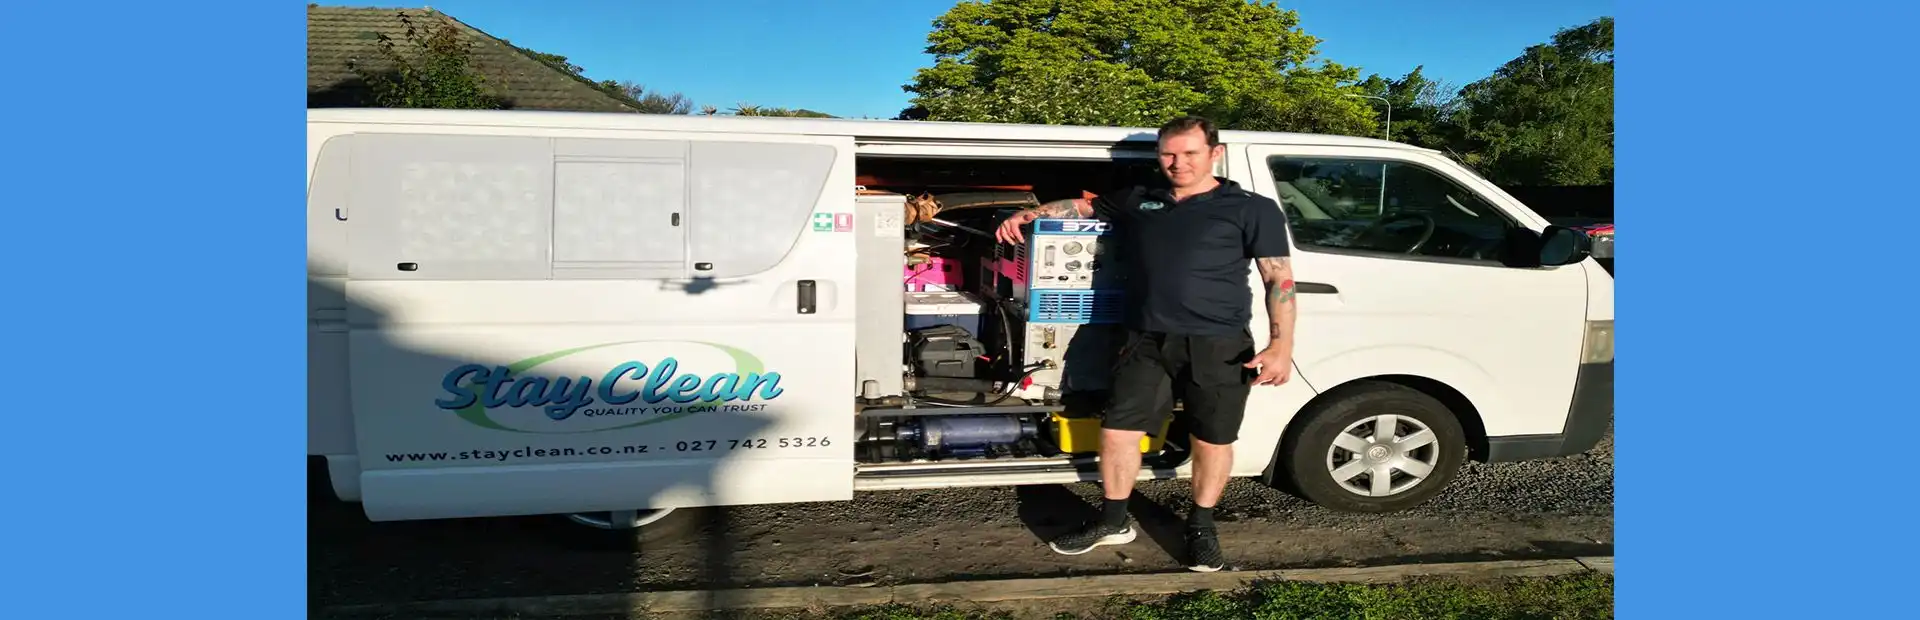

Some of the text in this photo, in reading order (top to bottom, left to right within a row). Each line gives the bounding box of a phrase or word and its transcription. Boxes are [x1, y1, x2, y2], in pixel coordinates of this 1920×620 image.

[584, 404, 768, 417] QUALITY YOU CAN TRUST
[385, 444, 649, 462] www.stayclean.co.nz
[675, 440, 717, 452] 027
[727, 438, 768, 450] 742
[778, 436, 831, 448] 5326
